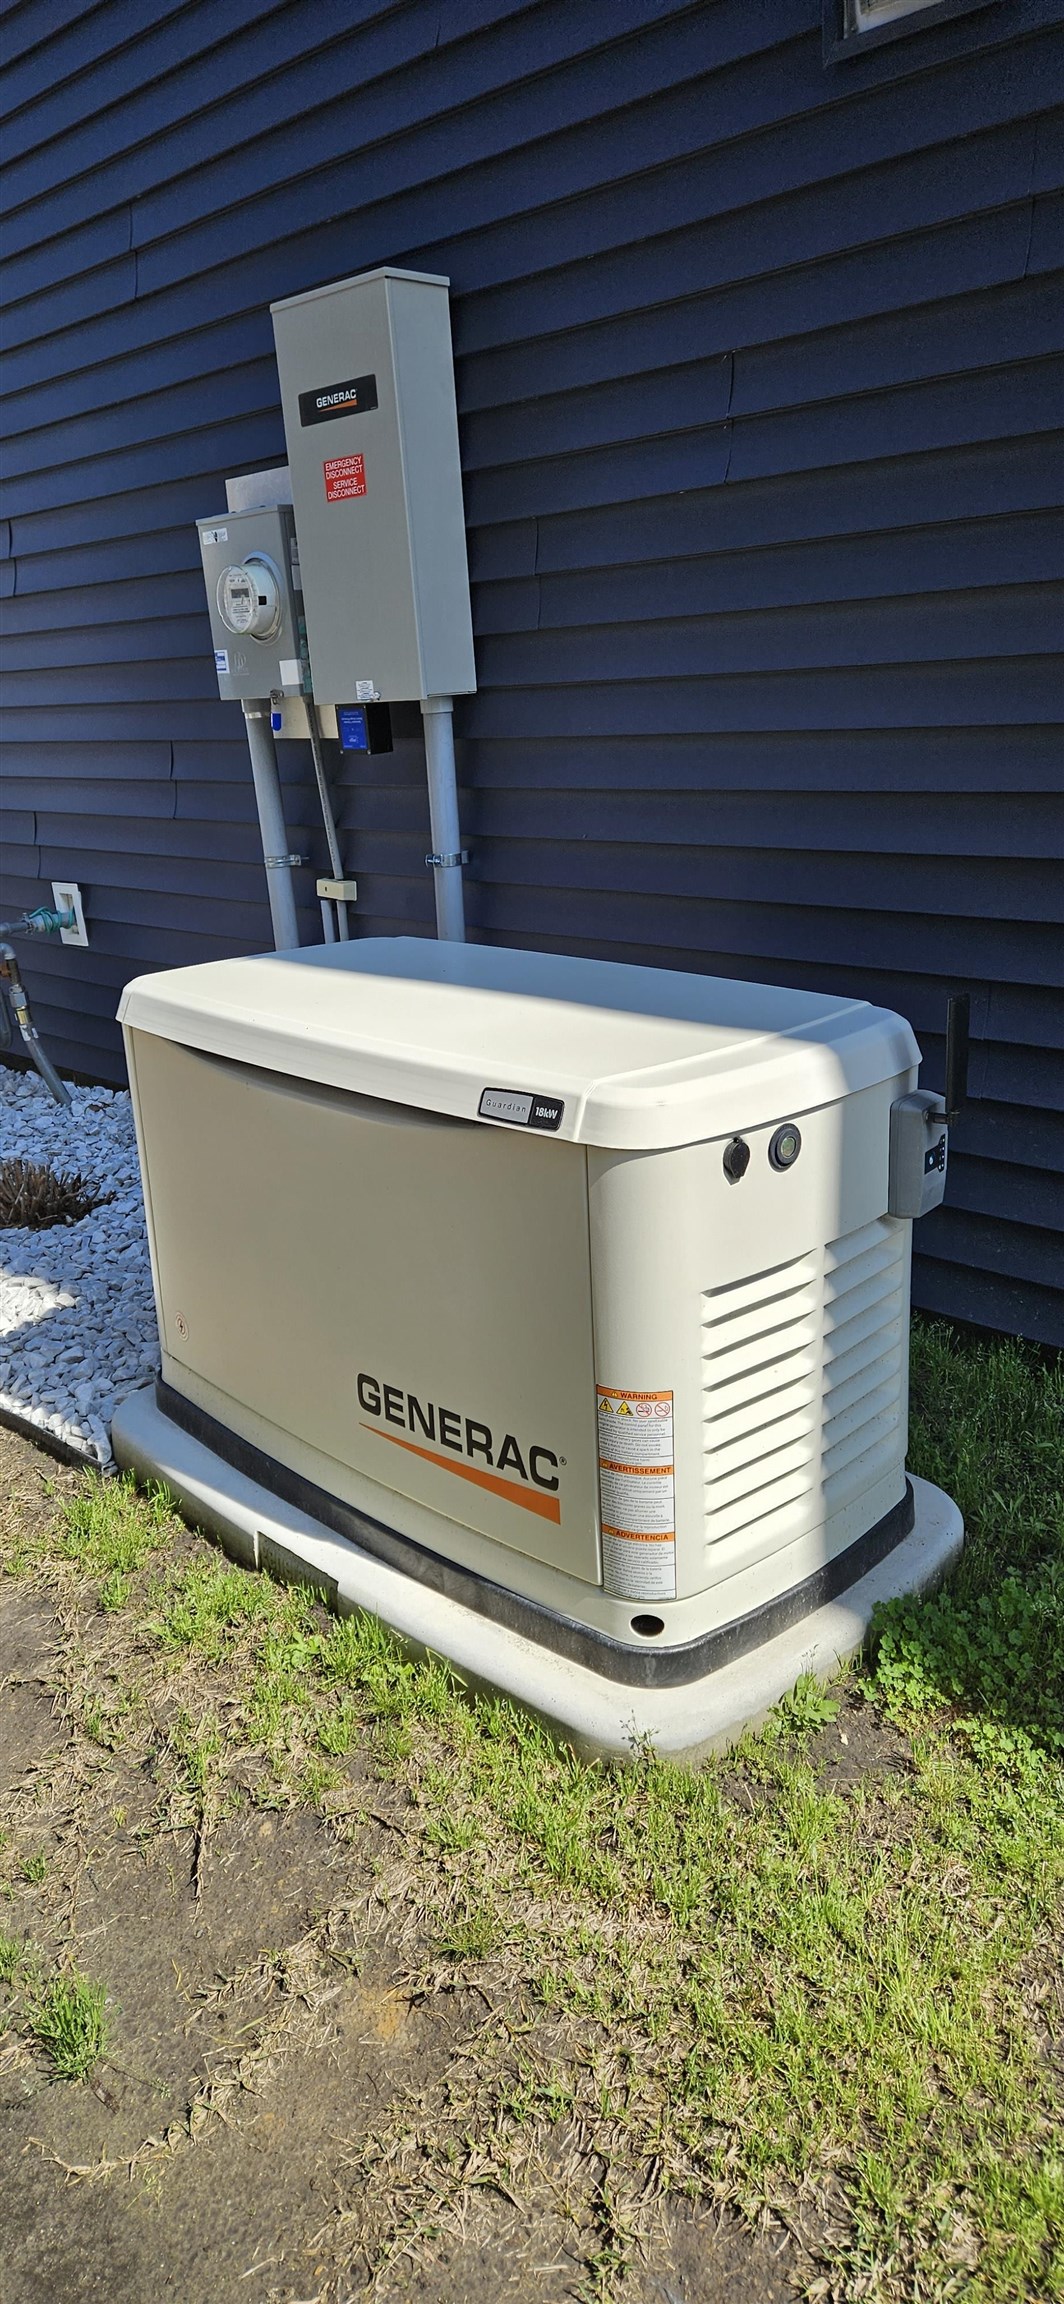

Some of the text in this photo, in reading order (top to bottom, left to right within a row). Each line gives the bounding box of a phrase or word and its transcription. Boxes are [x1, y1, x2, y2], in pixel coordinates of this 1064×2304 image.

[316, 388, 357, 408] GENERAC
[325, 456, 362, 471] EMERGENCY
[326, 464, 363, 480] DISCONNECT
[333, 477, 358, 490] SERVICE
[328, 485, 365, 500] DISCONNECT
[486, 1098, 558, 1120] Guardian 18kW
[620, 1392, 658, 1400] WARNING
[609, 1463, 671, 1474] AVERTISSEMENT
[616, 1531, 669, 1541] ADVERTENCIA
